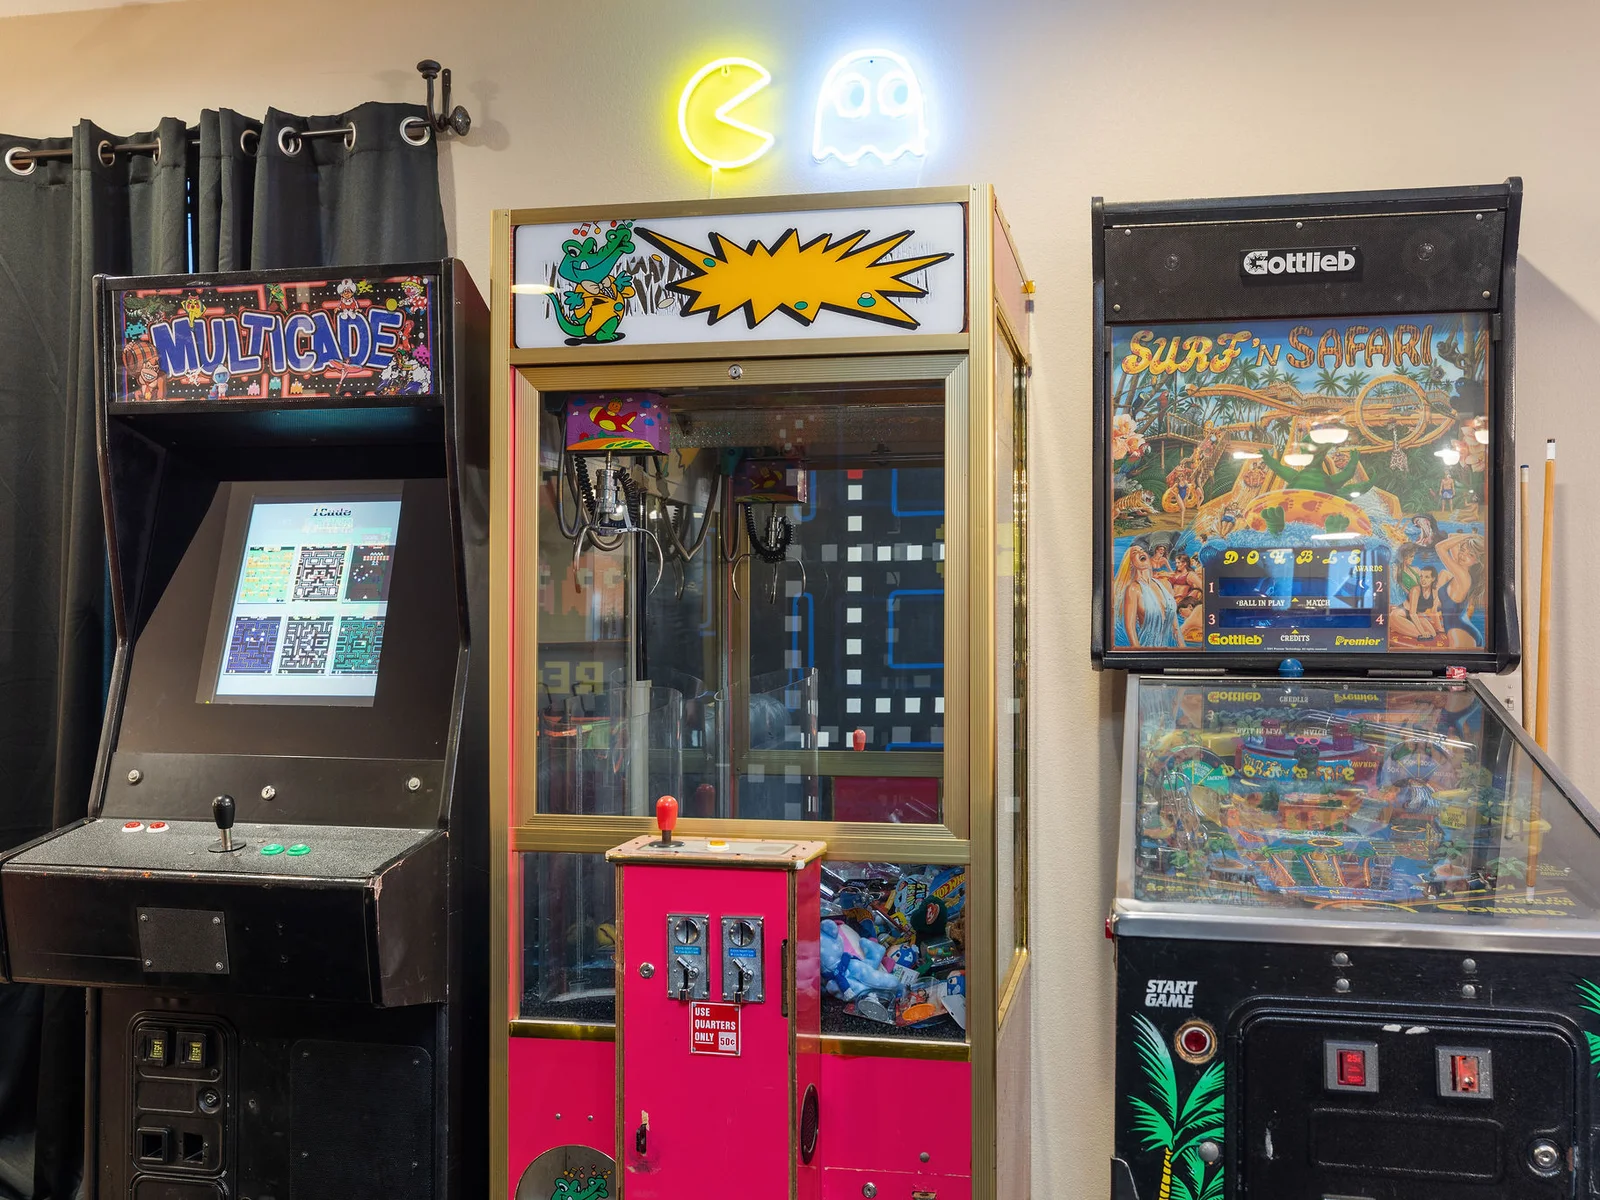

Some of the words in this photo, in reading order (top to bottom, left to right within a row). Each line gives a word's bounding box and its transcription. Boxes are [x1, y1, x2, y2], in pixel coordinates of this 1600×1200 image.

[1243, 249, 1356, 275] Gottlieb
[151, 309, 402, 377] MULTICADE
[1121, 330, 1252, 375] SURF
[1286, 323, 1434, 368] SAFARI
[1353, 565, 1383, 573] AWARDS
[1208, 582, 1214, 593] 1
[1376, 582, 1383, 592] 2
[1238, 599, 1257, 607] BALL
[1258, 599, 1266, 607] IN
[1268, 599, 1285, 607] PLAY
[1306, 599, 1331, 607] MATCH
[1208, 614, 1215, 625] 3
[1376, 614, 1384, 625] 4
[1208, 633, 1263, 646] Gottlieb
[1280, 634, 1310, 642] CREDITS
[1335, 635, 1382, 646] Premier
[1146, 979, 1197, 995] START
[1145, 993, 1195, 1009] GAME
[695, 1007, 710, 1017] USE
[694, 1019, 736, 1031] QUARTERS
[694, 1032, 715, 1043] ONLY
[720, 1037, 735, 1046] 50¢
